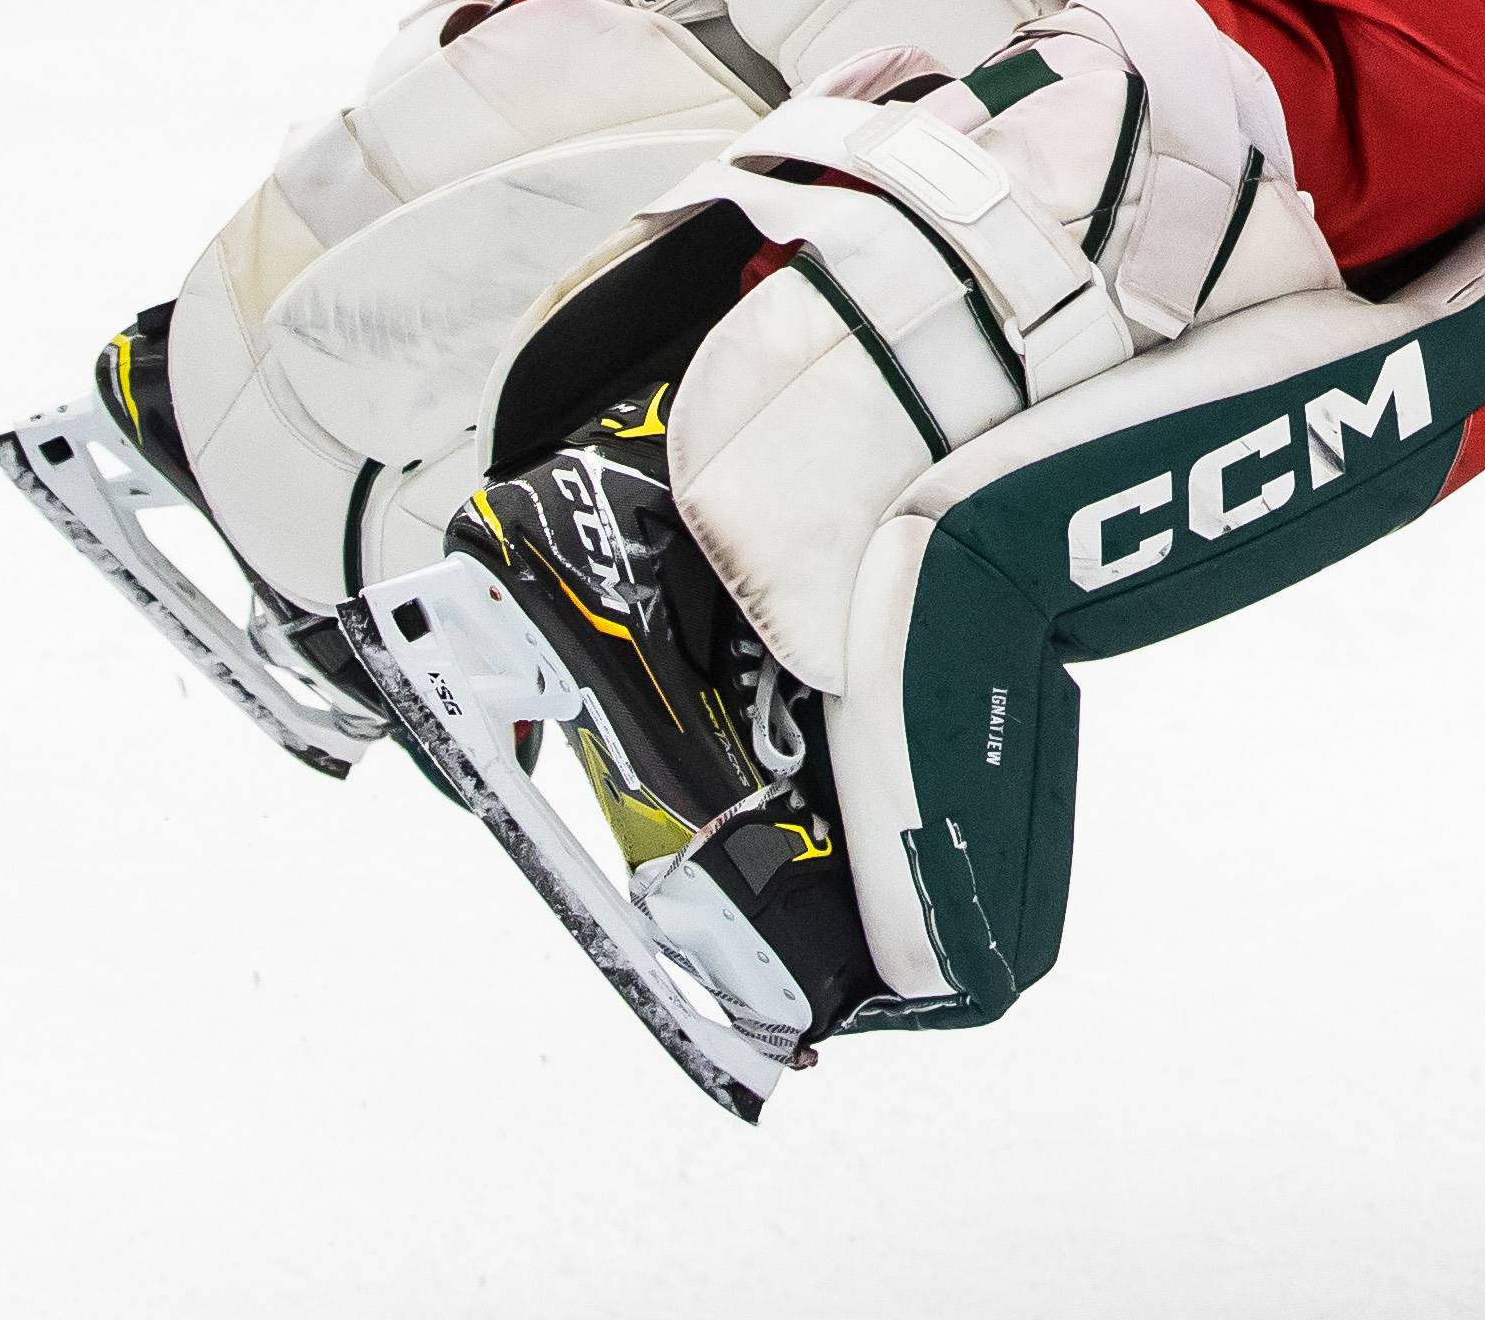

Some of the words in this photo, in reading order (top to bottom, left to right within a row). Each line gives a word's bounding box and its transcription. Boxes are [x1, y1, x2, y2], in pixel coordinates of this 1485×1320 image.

[551, 466, 631, 615] CCM
[1067, 339, 1433, 593] CCM
[985, 686, 1009, 766] IGNATJEW
